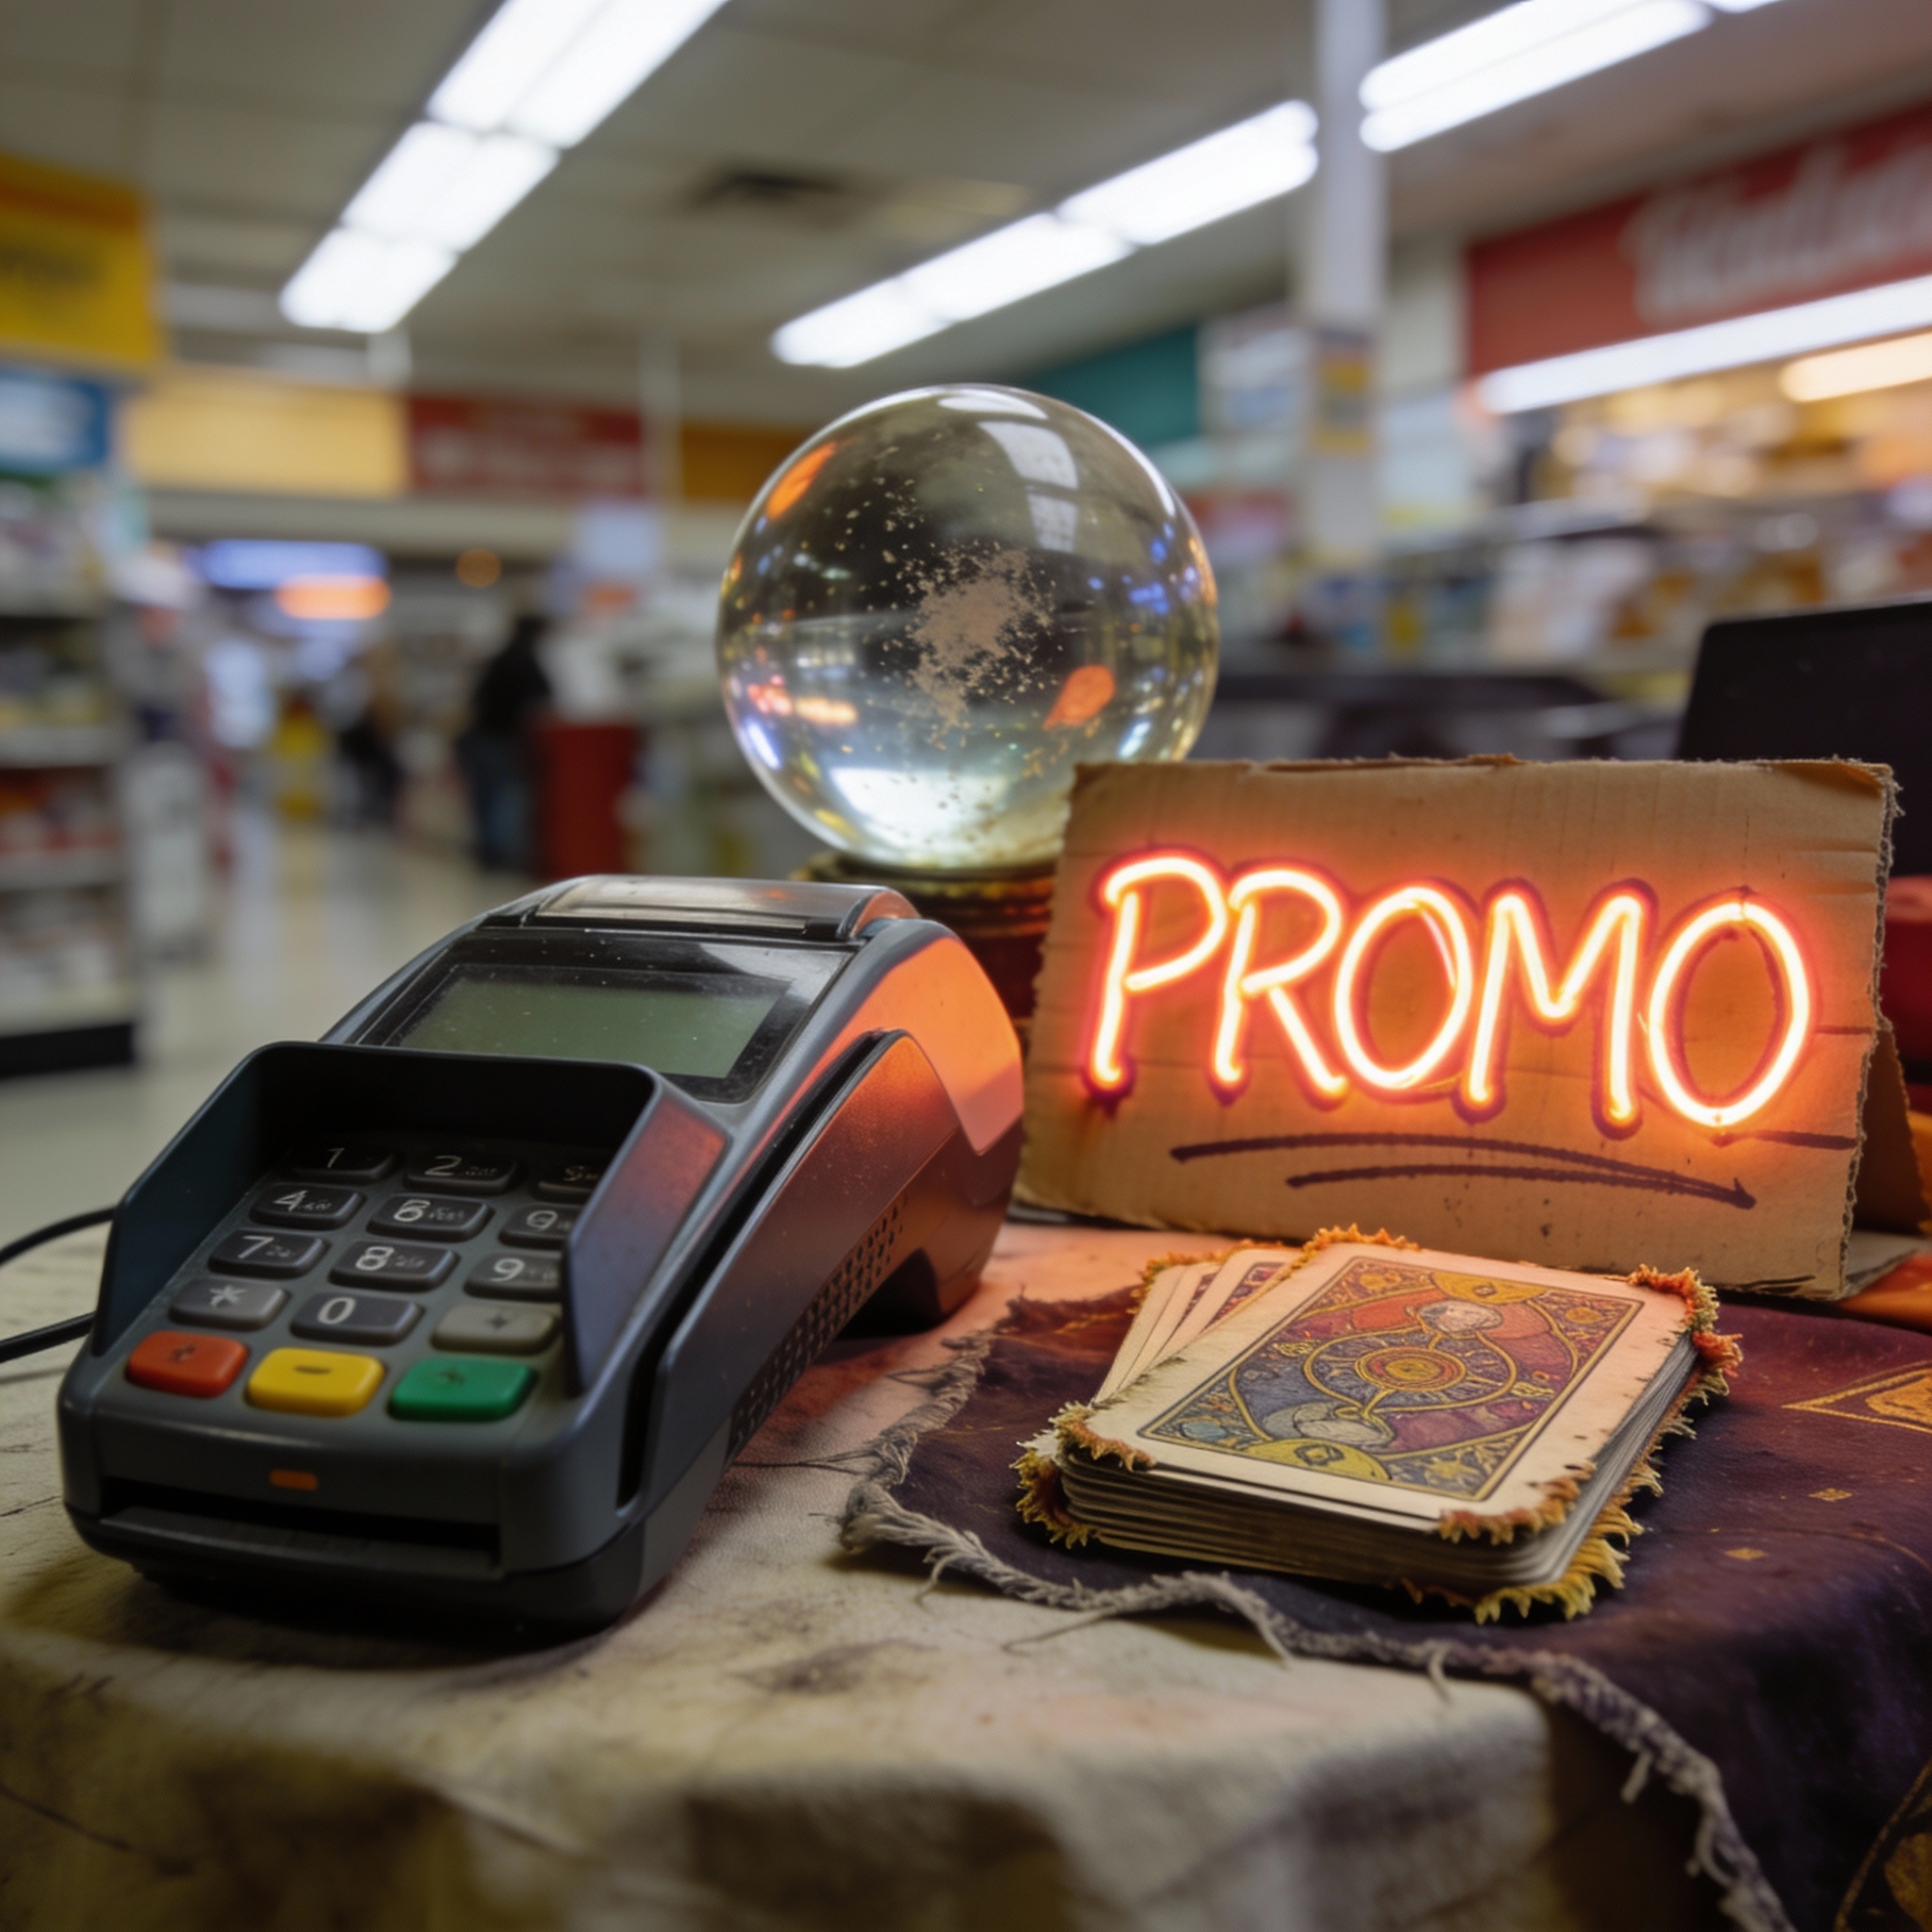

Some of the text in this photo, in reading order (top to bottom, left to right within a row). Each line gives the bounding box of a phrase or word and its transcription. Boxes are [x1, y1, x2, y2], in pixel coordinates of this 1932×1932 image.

[1091, 855, 1813, 1130] PROMO
[425, 1155, 462, 1176] 2
[274, 1190, 308, 1212] 4
[237, 1235, 275, 1259] 7
[355, 1245, 395, 1272] 8
[491, 1257, 525, 1283] 9
[317, 1296, 357, 1325] 0
